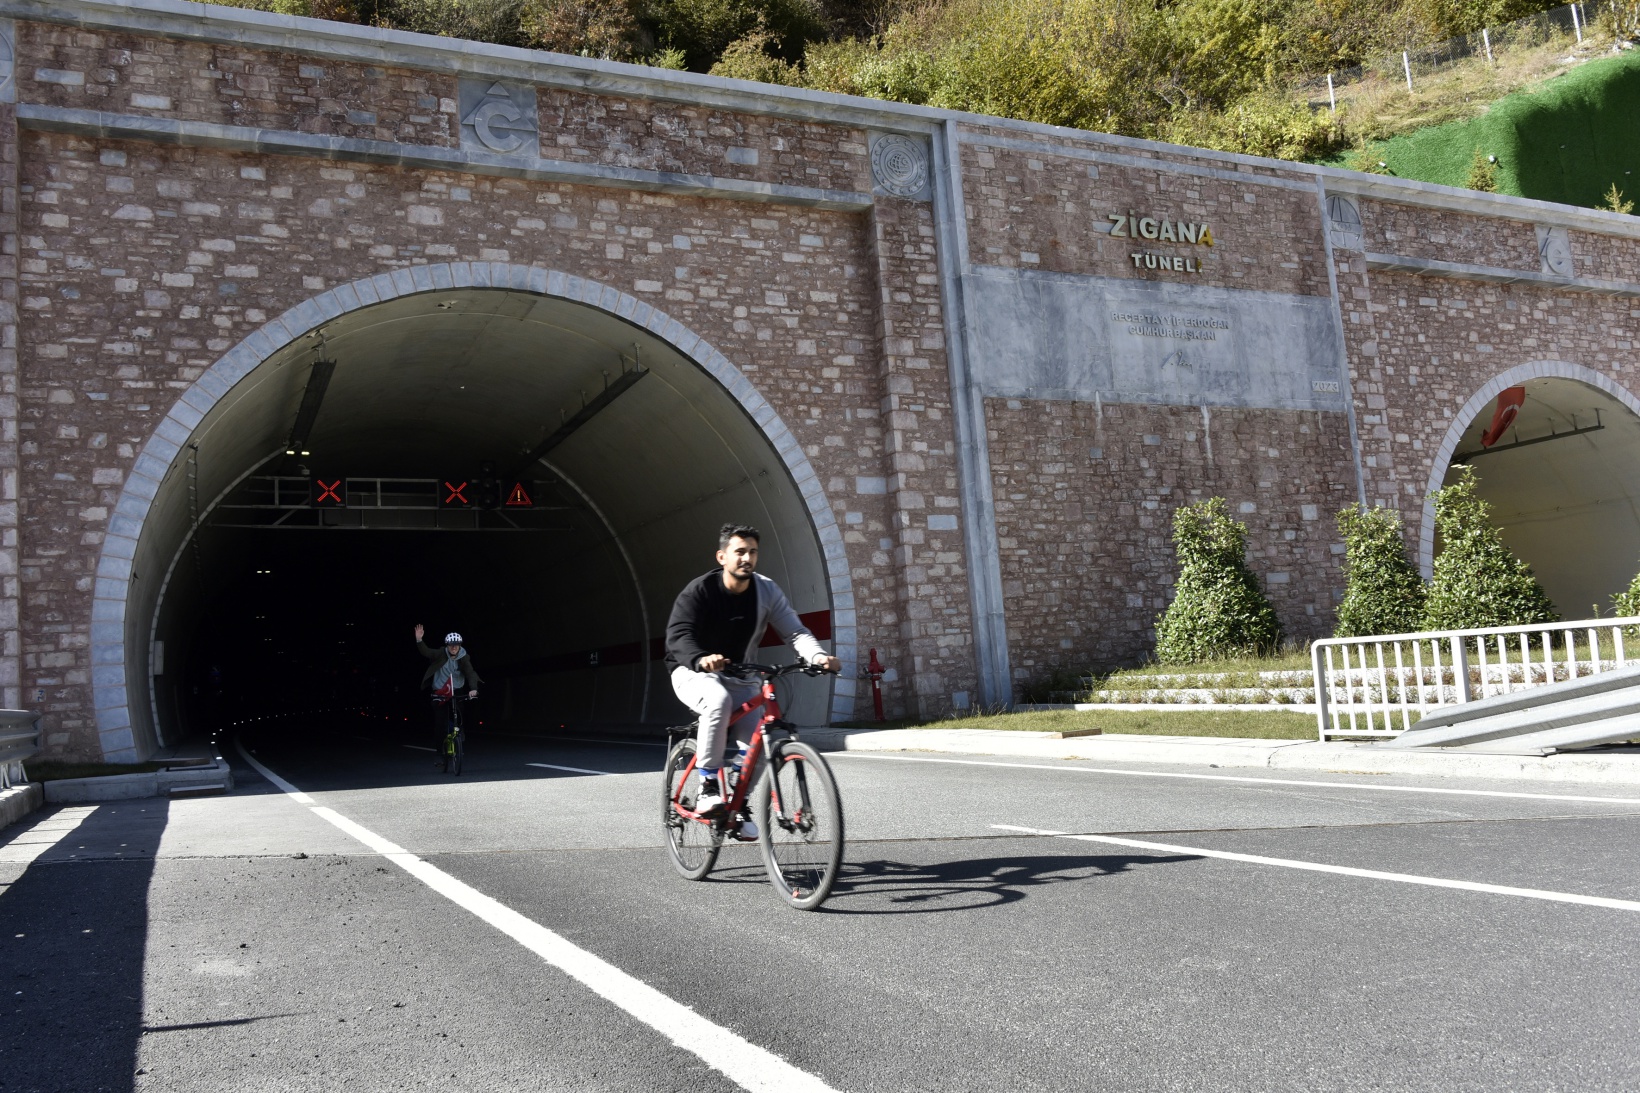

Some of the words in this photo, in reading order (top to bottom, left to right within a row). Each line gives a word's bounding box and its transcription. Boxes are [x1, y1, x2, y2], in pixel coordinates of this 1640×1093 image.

[1108, 209, 1215, 247] ZİGANA
[1111, 312, 1146, 324] RECEP
[1146, 314, 1182, 327] TAYYİP
[1184, 317, 1229, 330] ERDOĞAN
